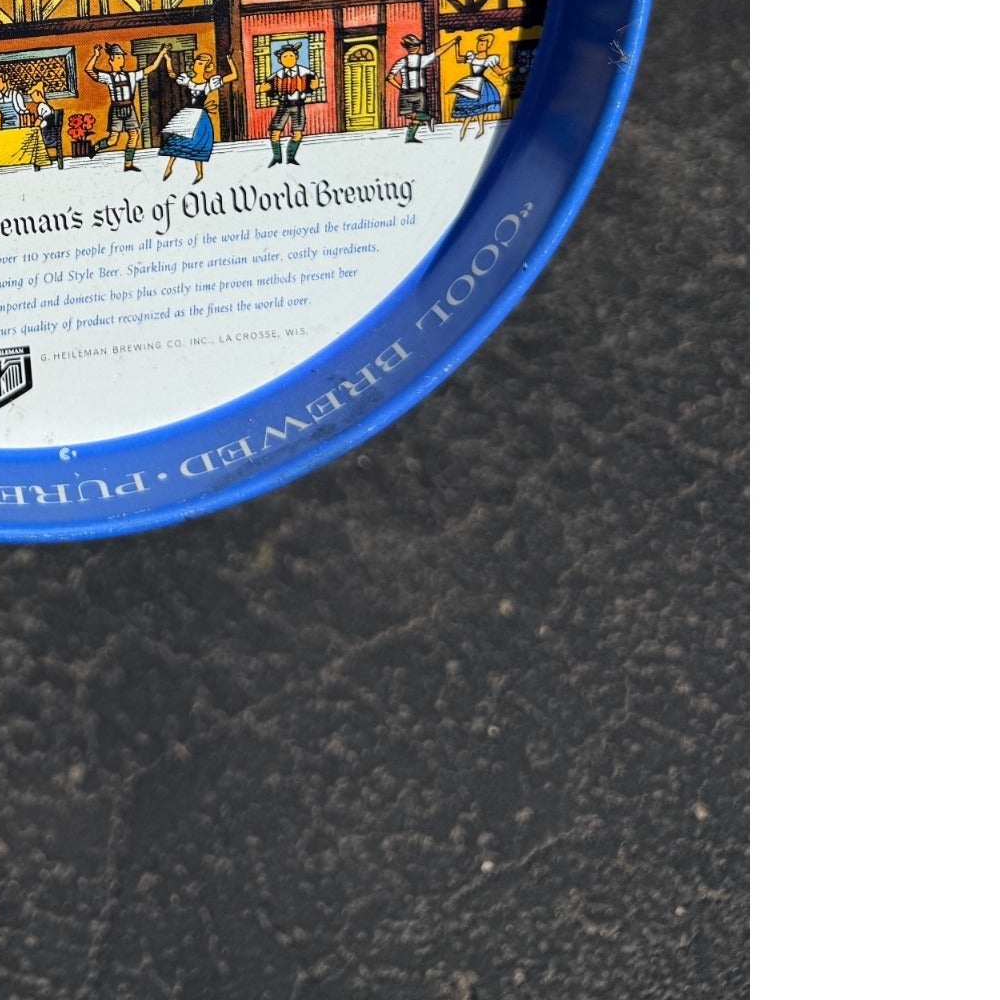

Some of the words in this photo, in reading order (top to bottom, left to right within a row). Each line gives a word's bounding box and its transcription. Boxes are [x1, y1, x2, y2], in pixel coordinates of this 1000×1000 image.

[92, 197, 144, 231] style
[152, 194, 177, 235] of
[182, 191, 226, 218] Old
[230, 182, 309, 213] World
[311, 178, 416, 207] Brewing
[22, 253, 39, 262] 110
[42, 249, 71, 263] years
[75, 243, 106, 259] people
[108, 241, 134, 256] from
[138, 238, 152, 250] all
[156, 238, 183, 252] parts
[187, 234, 198, 248] of
[202, 233, 217, 245] the
[221, 229, 250, 242] world
[254, 228, 278, 240] have
[282, 223, 320, 238] enjoyed
[324, 221, 339, 233] the
[342, 216, 396, 232] traditional
[400, 214, 416, 226] old
[28, 273, 40, 287] of
[43, 271, 63, 283] Old
[68, 268, 94, 283] Style
[99, 266, 122, 278] Beer.
[126, 261, 177, 278] Sparkling
[181, 259, 204, 273] pure
[207, 255, 247, 268] artesian
[287, 246, 318, 262] costly
[40, 295, 60, 307] and
[63, 291, 105, 305] domestic
[110, 289, 133, 302] hops
[136, 286, 157, 300] plus
[160, 282, 192, 296] costly
[195, 281, 216, 292] time
[219, 278, 252, 292] proven
[256, 273, 296, 286] methods
[300, 269, 335, 284] present
[339, 267, 358, 279] beer
[20, 320, 58, 335] quality
[62, 317, 73, 330] of
[76, 314, 114, 330] product
[118, 308, 170, 324] recognized
[174, 309, 185, 317] as
[189, 305, 204, 316] the
[205, 301, 233, 318] finest
[237, 300, 251, 312] the
[255, 296, 284, 309] world
[287, 297, 311, 306] over.
[53, 347, 107, 361] HEILEMAN
[112, 341, 162, 354] BREWING
[219, 334, 232, 343] LA
[235, 330, 280, 341] CROSSE,
[285, 327, 308, 337] WIS.
[178, 336, 414, 478] BREWED
